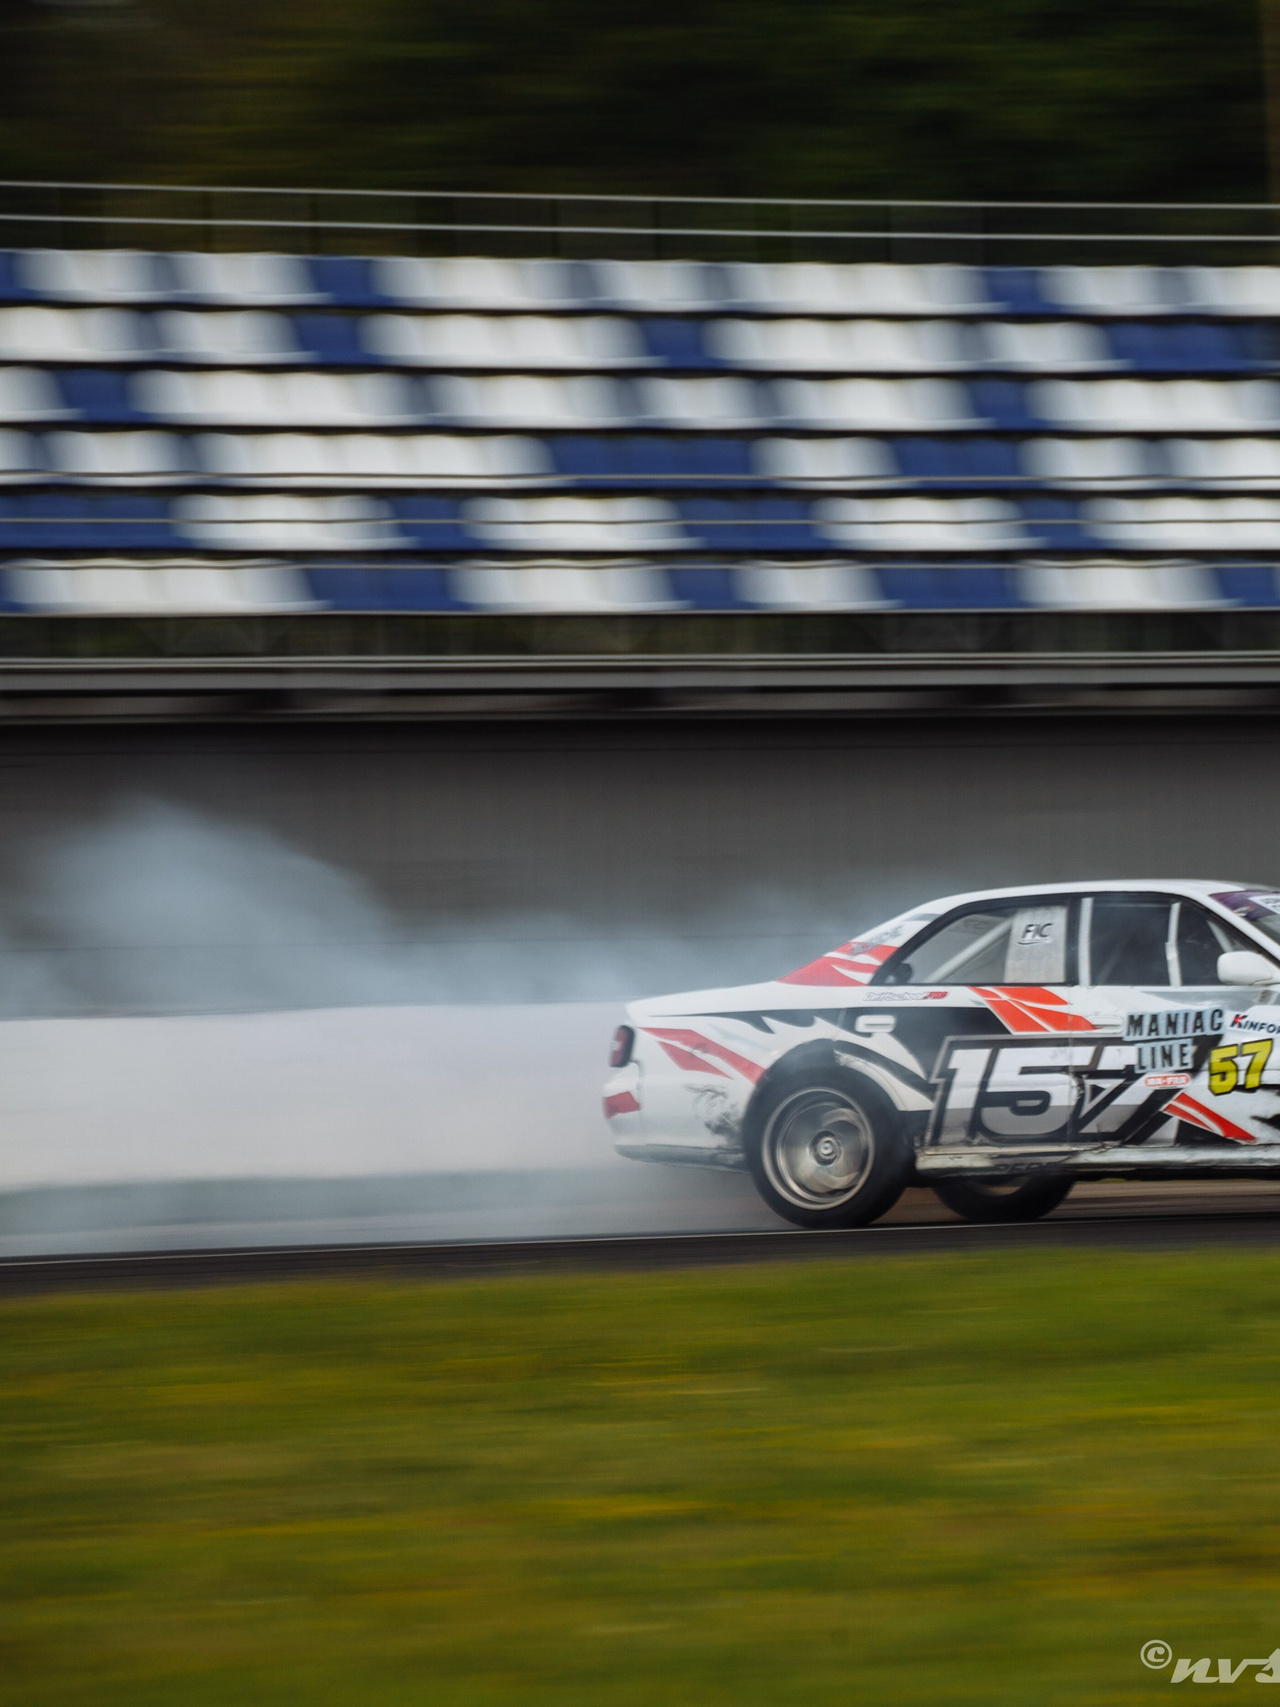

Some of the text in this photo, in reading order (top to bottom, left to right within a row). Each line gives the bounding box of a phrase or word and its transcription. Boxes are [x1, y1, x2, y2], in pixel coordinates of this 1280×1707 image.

[1020, 922, 1054, 939] FIC
[1126, 1008, 1224, 1037] MANIAC
[1137, 1043, 1190, 1071] LINE
[1208, 1038, 1274, 1096] 57
